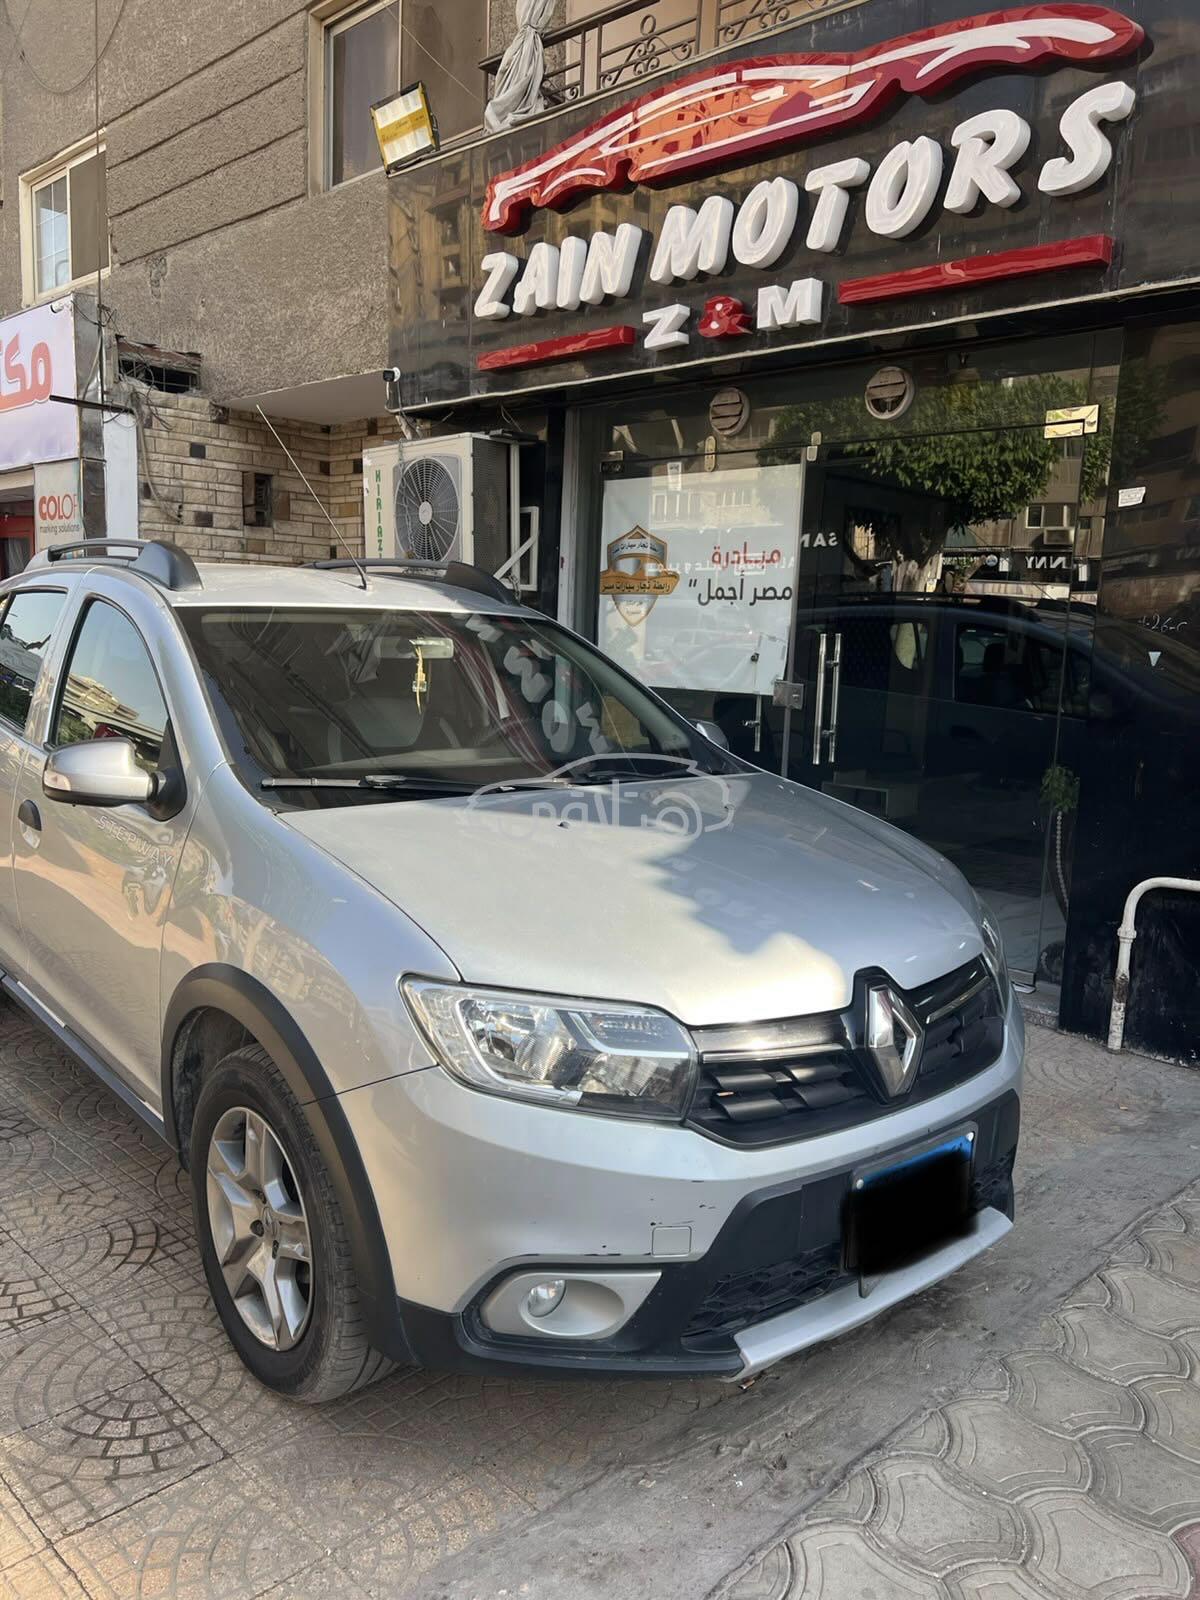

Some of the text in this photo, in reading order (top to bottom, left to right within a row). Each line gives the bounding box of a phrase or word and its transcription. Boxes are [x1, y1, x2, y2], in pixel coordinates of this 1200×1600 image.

[473, 80, 1136, 321] ZAIN MOTORS
[711, 541, 781, 571] مبادرة
[749, 586, 793, 606] مصر
[97, 815, 174, 867] STEPWAY
